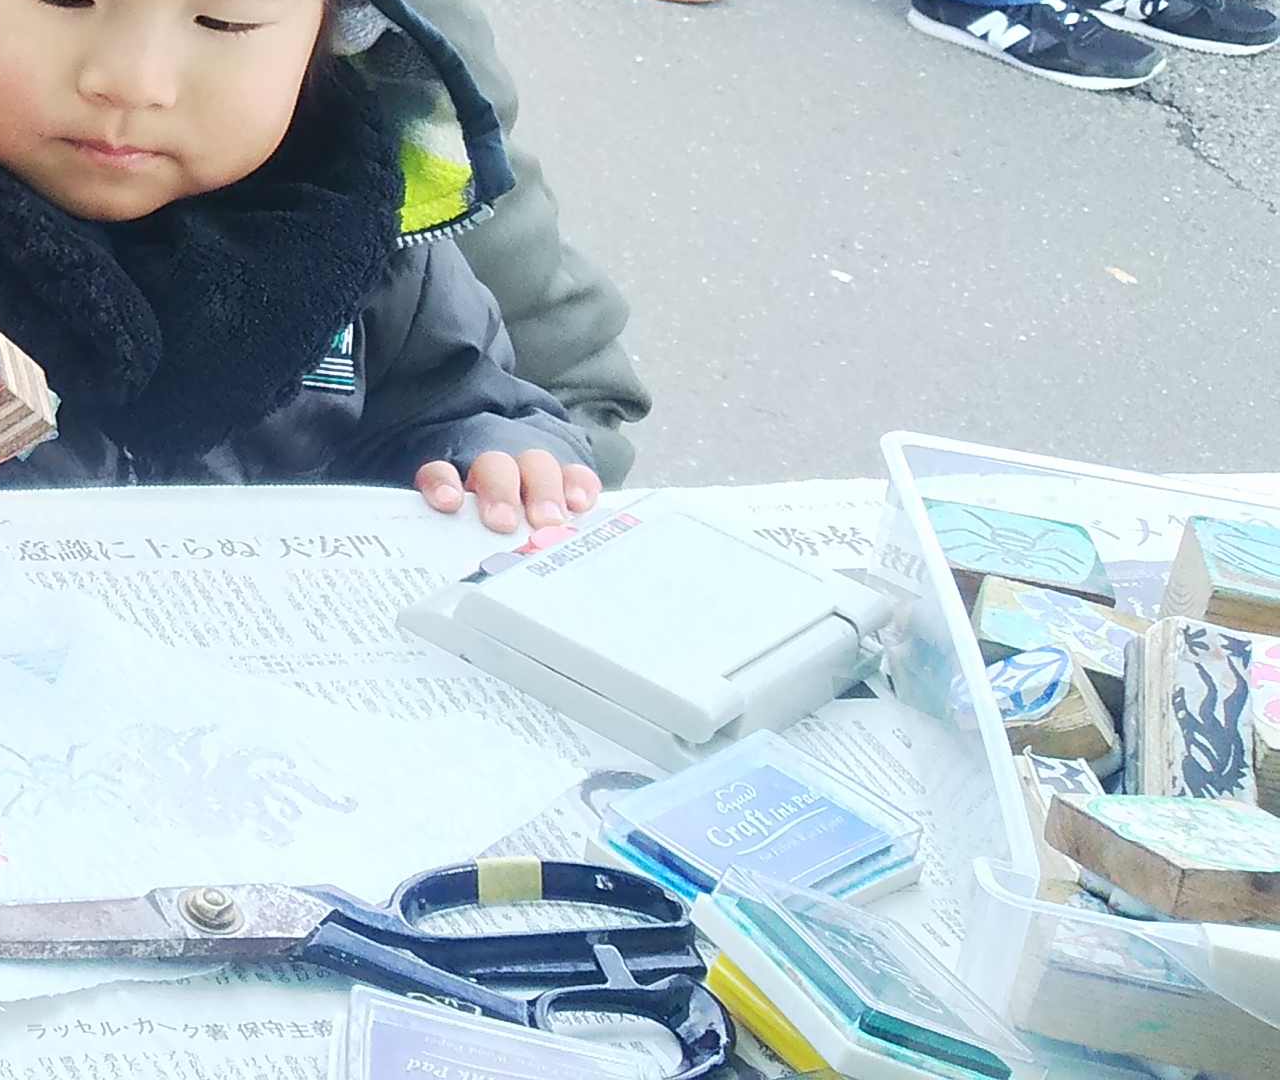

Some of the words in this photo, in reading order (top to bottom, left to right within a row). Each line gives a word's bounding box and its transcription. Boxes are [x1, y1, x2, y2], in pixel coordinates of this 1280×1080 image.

[966, 10, 1032, 52] N
[705, 808, 772, 848] Craft
[767, 801, 799, 822] Ink
